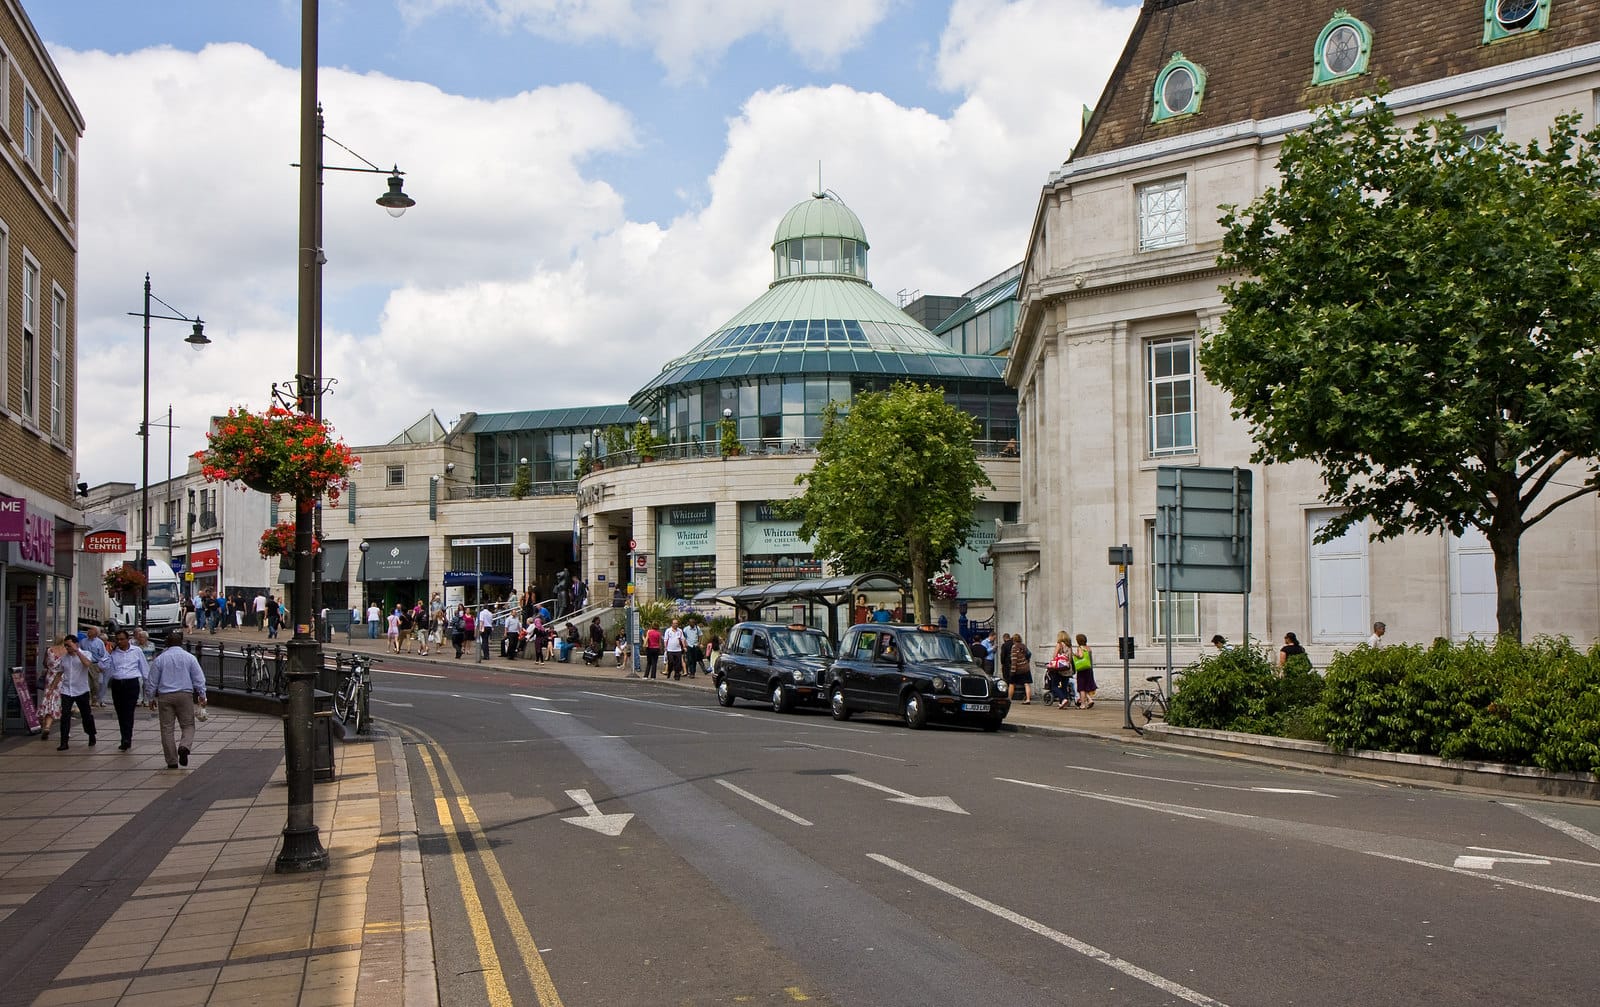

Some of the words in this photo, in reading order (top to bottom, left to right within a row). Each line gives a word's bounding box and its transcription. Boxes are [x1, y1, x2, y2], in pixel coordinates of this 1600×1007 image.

[0, 502, 20, 512] ME
[672, 508, 707, 519] Whittard
[677, 529, 708, 540] Whittard
